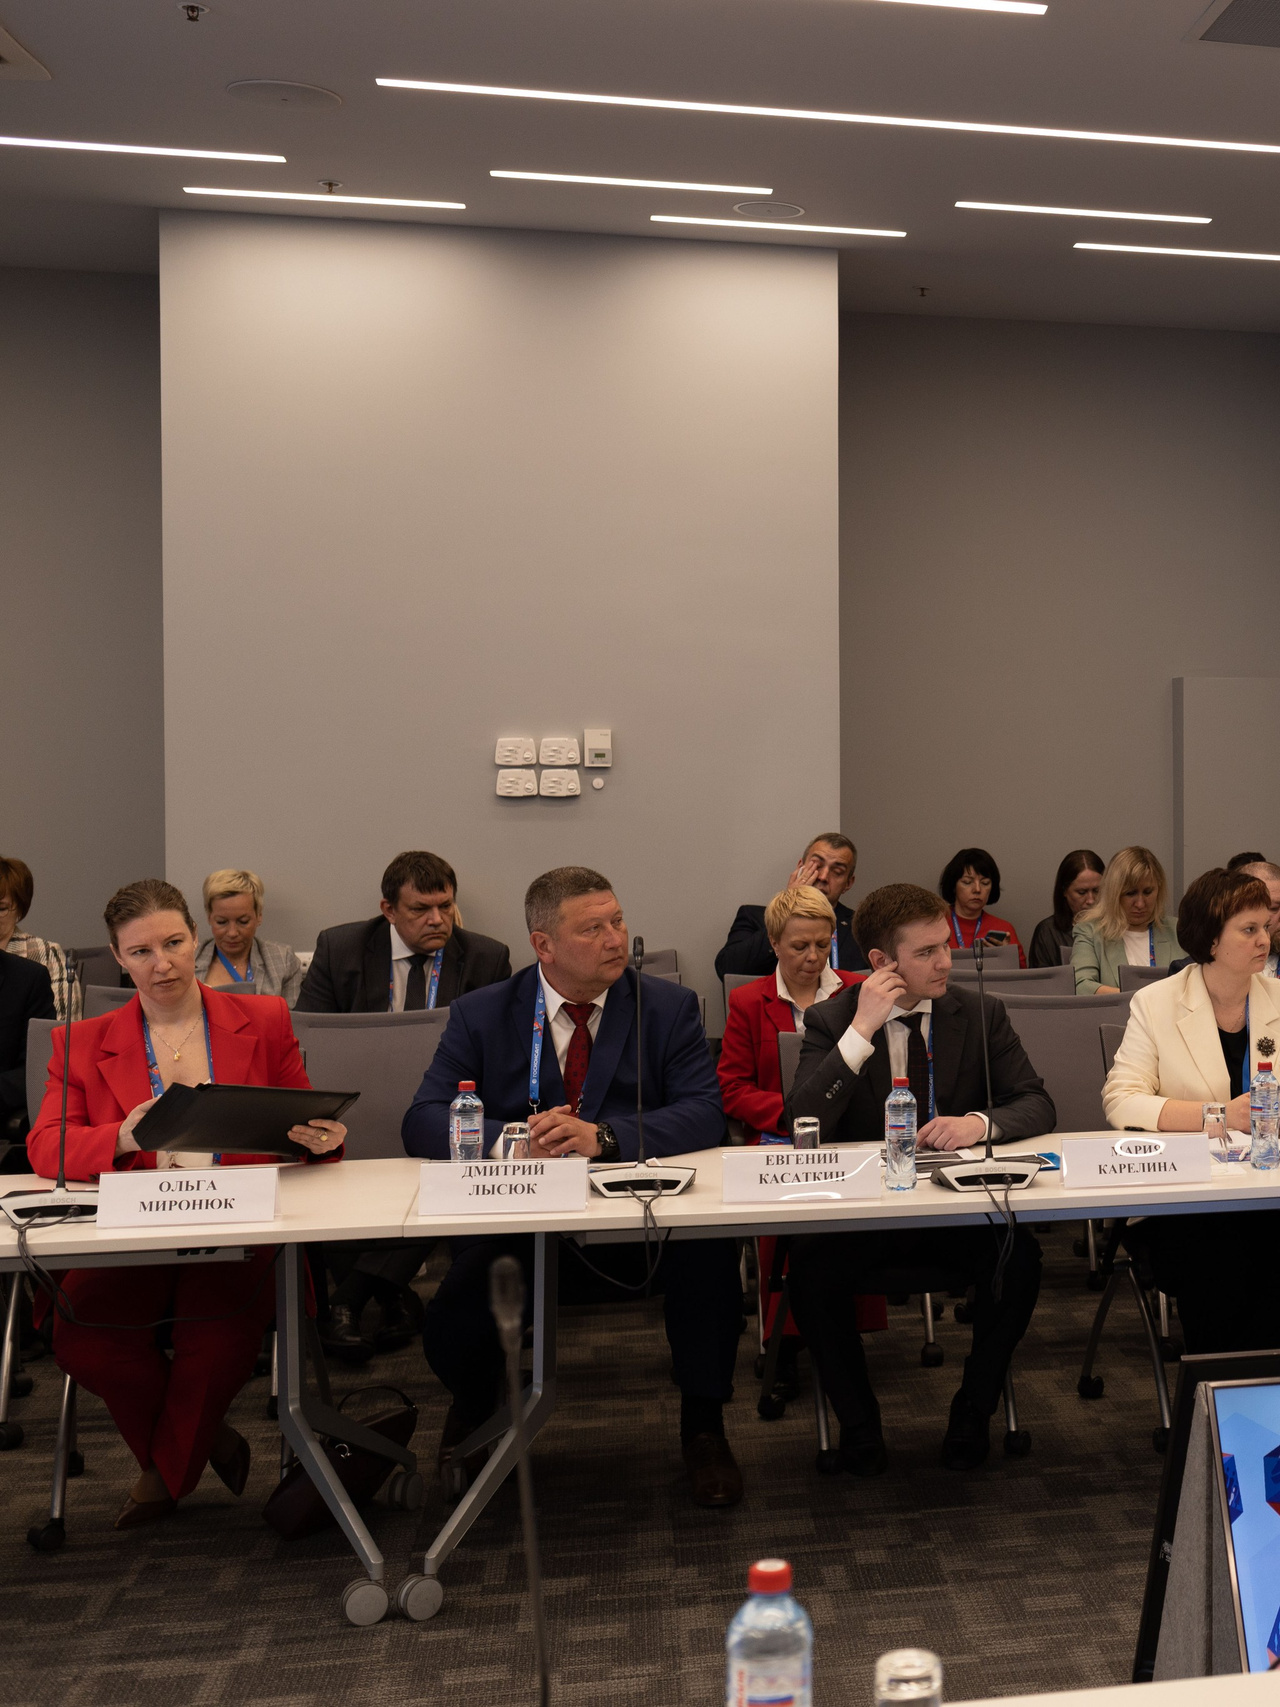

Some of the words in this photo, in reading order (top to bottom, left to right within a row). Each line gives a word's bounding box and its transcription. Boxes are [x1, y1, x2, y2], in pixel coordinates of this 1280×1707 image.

[765, 1150, 839, 1167] ЕВГЕНИЙ
[461, 1162, 545, 1179] ДМИТРИЙ
[634, 1171, 658, 1179] BOSCH
[1098, 1162, 1178, 1175] КАРЕЛИНА
[758, 1170, 846, 1185] КАСАТКИН
[158, 1179, 217, 1193] ОЛЬГА
[468, 1183, 538, 1196] ЛЫСЮК
[138, 1197, 235, 1213] МИРОНЮК
